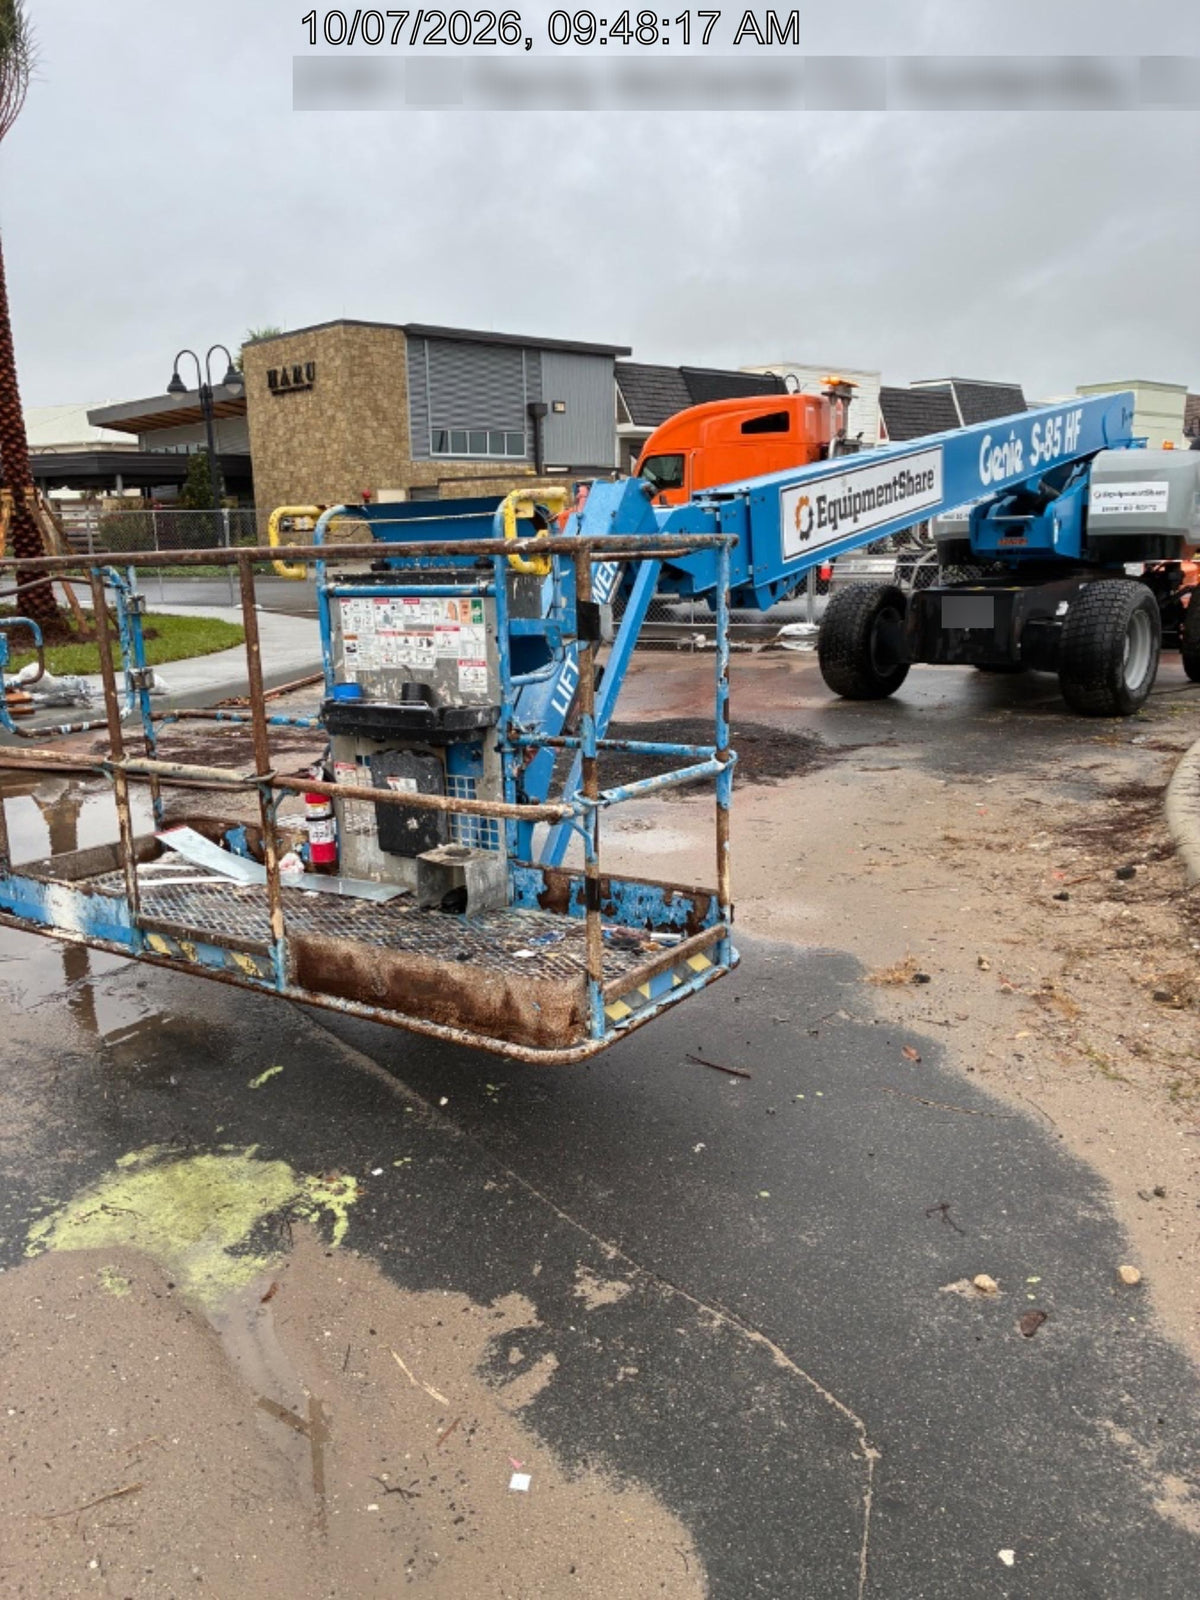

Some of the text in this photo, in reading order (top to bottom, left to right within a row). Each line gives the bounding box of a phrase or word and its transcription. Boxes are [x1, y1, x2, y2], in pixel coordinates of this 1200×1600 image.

[980, 408, 1083, 486] Genie S-85 HF
[816, 468, 934, 530] EquipmentShare
[551, 652, 580, 717] LIFT
